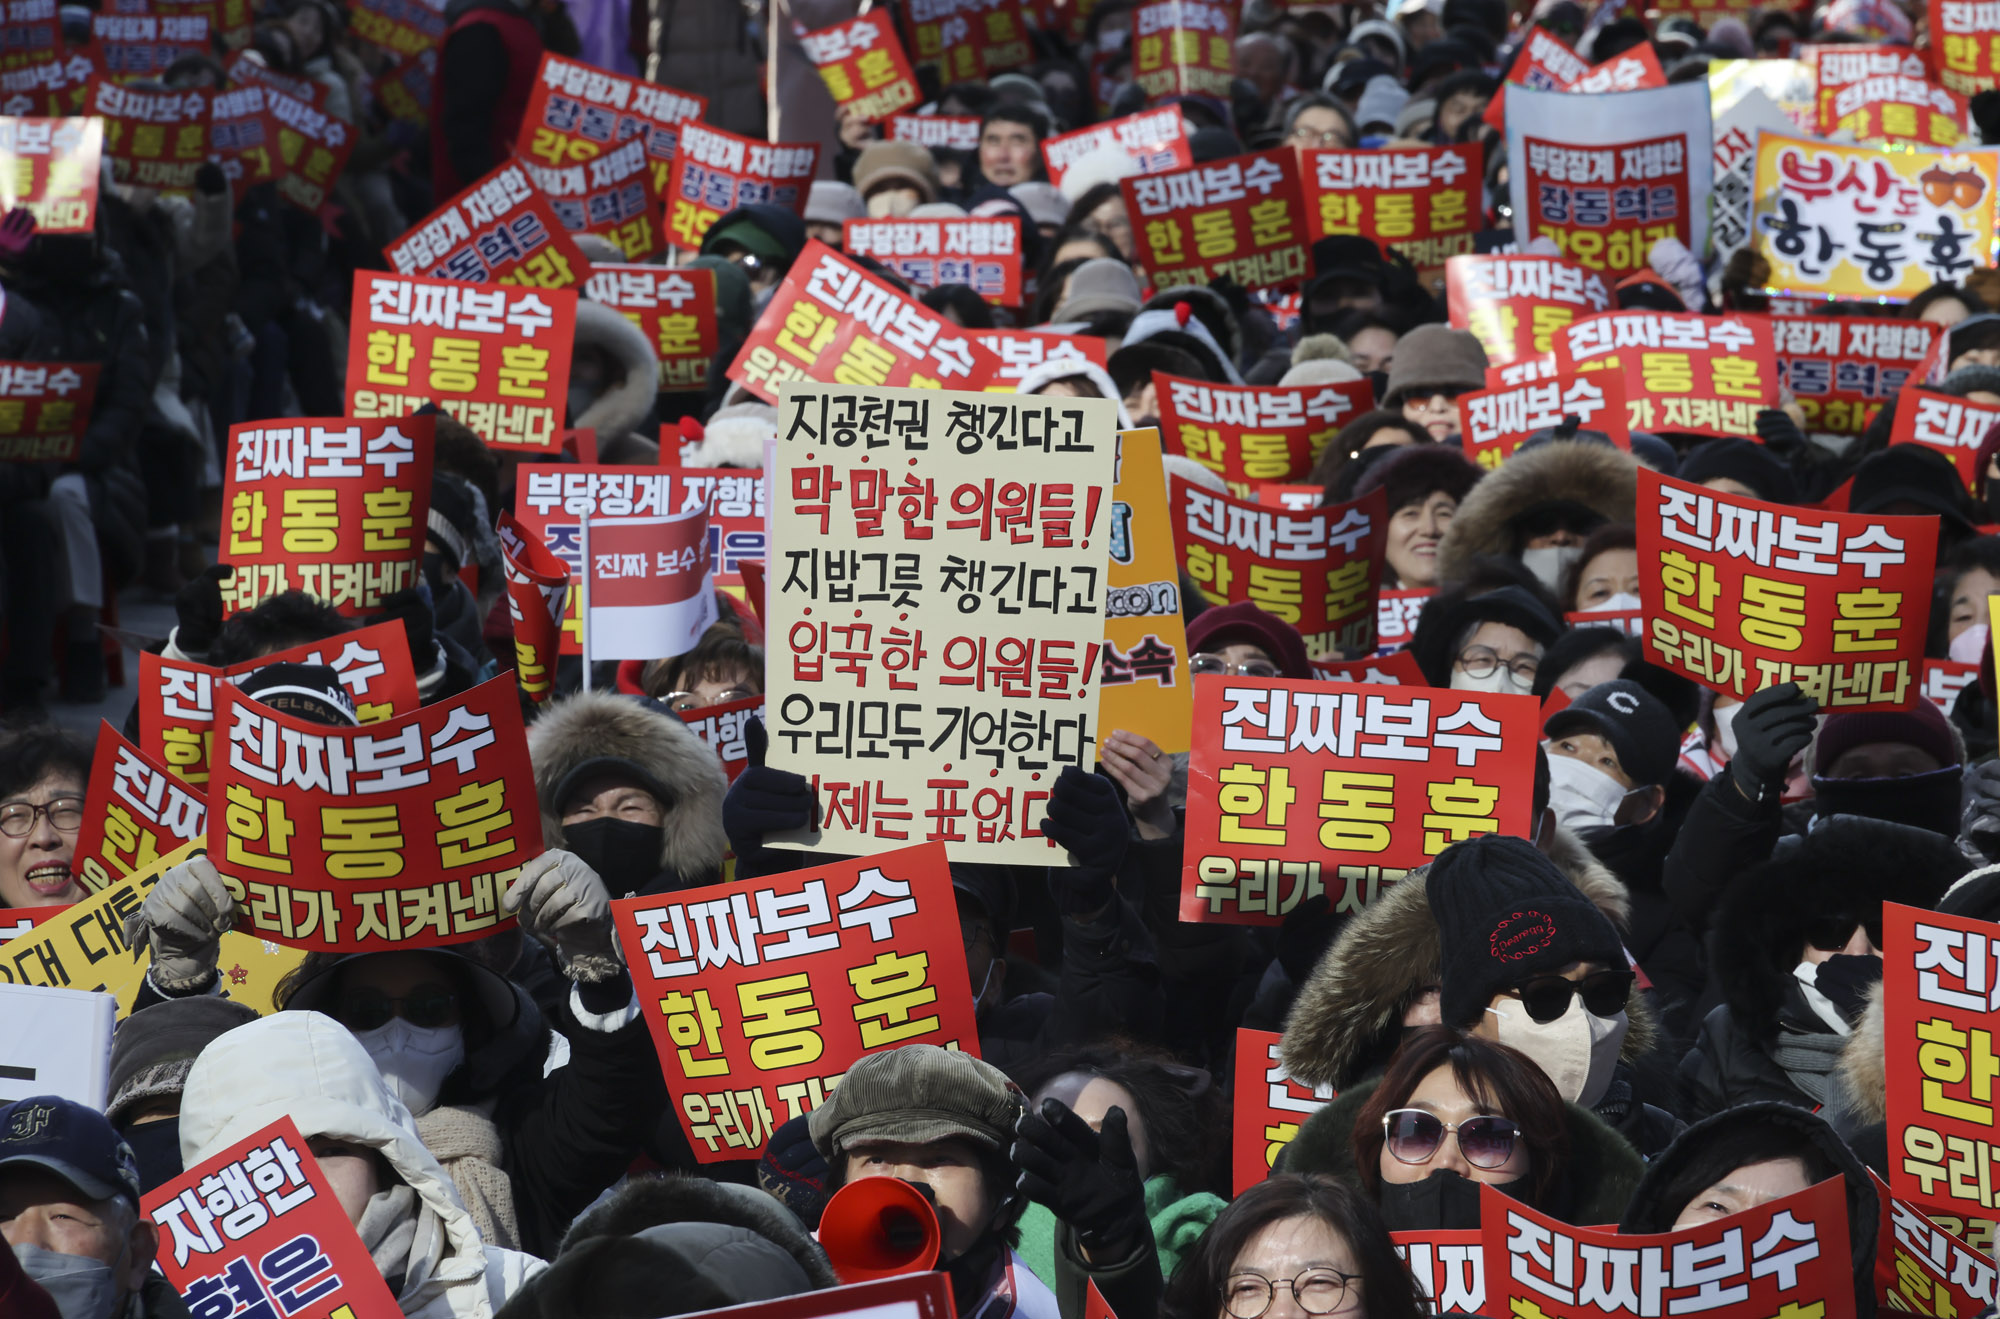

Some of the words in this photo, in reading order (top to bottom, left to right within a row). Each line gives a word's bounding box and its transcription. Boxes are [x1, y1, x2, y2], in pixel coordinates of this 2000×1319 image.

[680, 124, 745, 173] 부당징계
[1316, 152, 1467, 191] 진짜보수
[1529, 144, 1615, 184] 부당징계
[1621, 140, 1684, 176] 자행한
[461, 164, 533, 230] 자행한
[1135, 157, 1285, 216] 진짜보수
[1539, 185, 1678, 226] 장동혁은
[849, 222, 940, 256] 부당징계
[1145, 199, 1294, 265] 한동훈
[369, 278, 554, 338] 진짜보수
[805, 253, 976, 380] 진짜보수
[1466, 259, 1610, 311] 진짜보수
[366, 329, 550, 399] 한동훈
[774, 298, 943, 391] 한동
[1567, 314, 1756, 362] 진짜보수
[1847, 323, 1932, 360] 자행한
[1169, 380, 1353, 429] 진짜보수
[1576, 352, 1763, 399] 동훈
[786, 393, 930, 451] 지공천권
[945, 400, 1095, 456] 챙긴다고
[1467, 377, 1606, 444] 진짜보수
[235, 425, 415, 483] 진짜보수
[228, 486, 414, 556] 한동훈
[526, 472, 671, 516] 부당징계
[946, 477, 1102, 549] 의원들!
[1185, 488, 1371, 561] 진짜보수
[594, 552, 648, 580] 진짜
[656, 546, 698, 577] 보수
[1659, 482, 1907, 579] 진짜보수
[781, 547, 924, 609] 지밥그릇
[939, 553, 1098, 615] 챙긴다고
[1660, 549, 1903, 654] 한동훈
[939, 635, 1101, 700] 의원들!
[1651, 616, 1747, 697] 우리가
[229, 699, 496, 797] 진짜보수
[778, 693, 925, 759] 우리모두
[928, 705, 1097, 770] 기억한다
[1220, 687, 1503, 768] 진짜보수
[225, 777, 517, 881] 한동훈
[1217, 763, 1500, 857] 한동훈
[1195, 855, 1326, 917] 우리가
[634, 867, 919, 980] 진짜보수
[659, 950, 943, 1080] 한동훈
[150, 1137, 316, 1268] 자행한
[1506, 1208, 1820, 1319] 진짜보수
